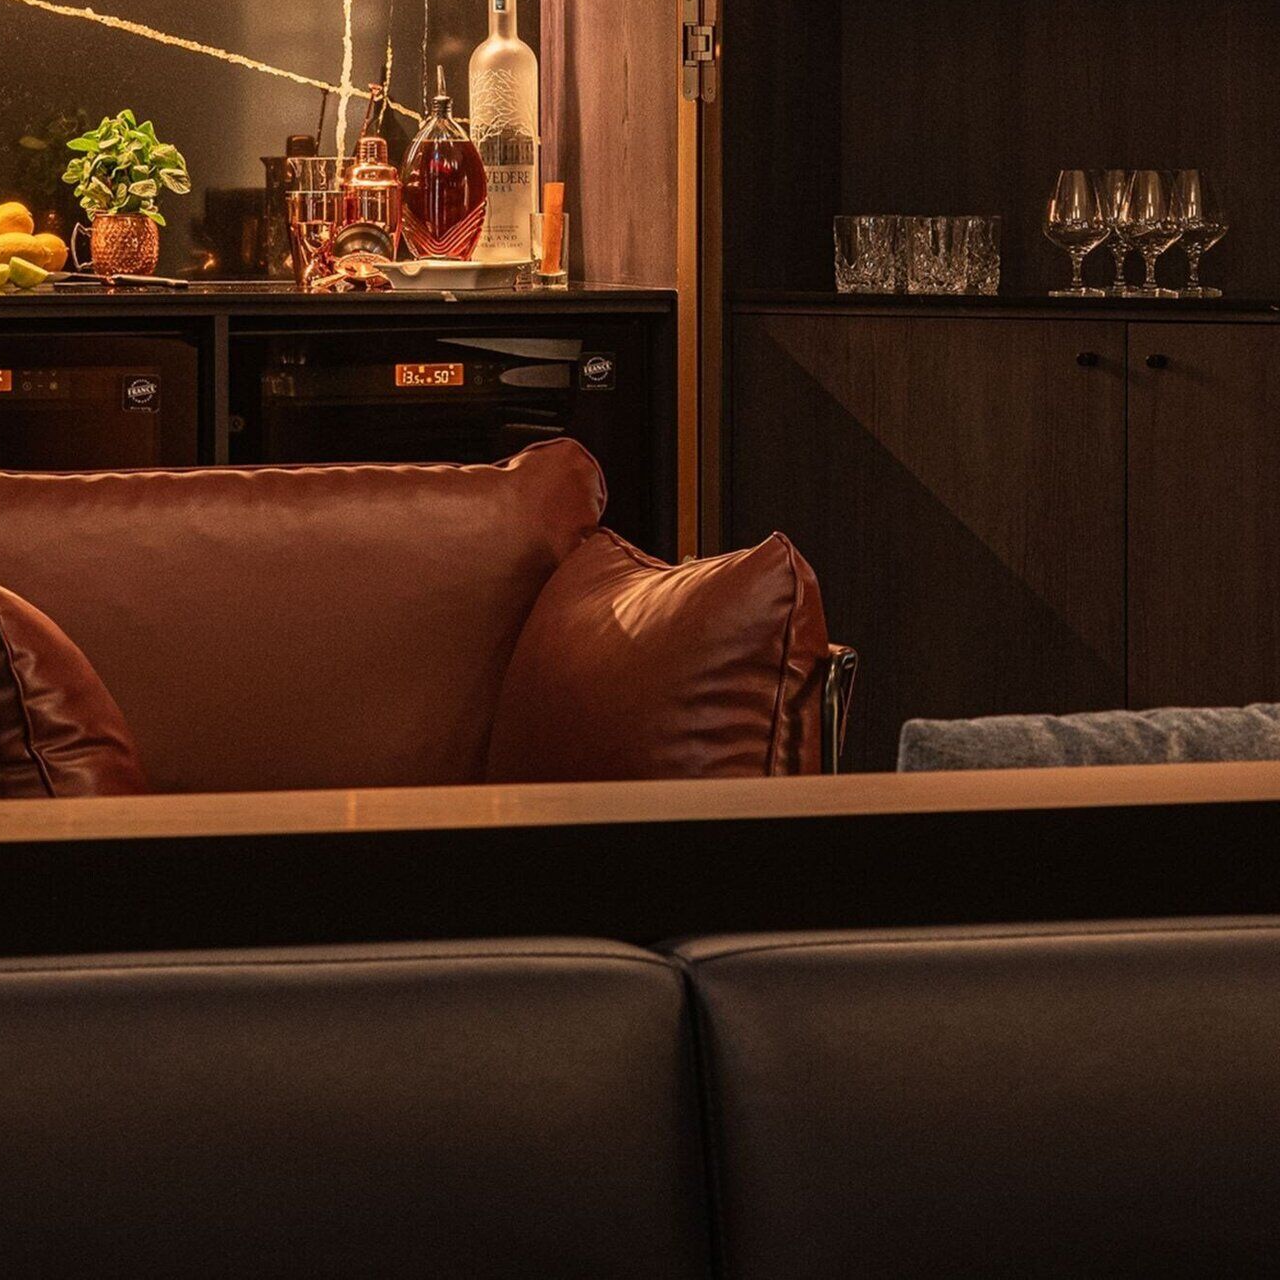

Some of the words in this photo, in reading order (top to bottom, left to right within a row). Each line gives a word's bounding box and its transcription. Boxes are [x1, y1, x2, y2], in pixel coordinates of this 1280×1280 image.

[486, 171, 530, 185] VEDERE
[583, 360, 612, 377] FRANCE
[434, 370, 449, 384] 50
[127, 383, 157, 398] FRANCE
